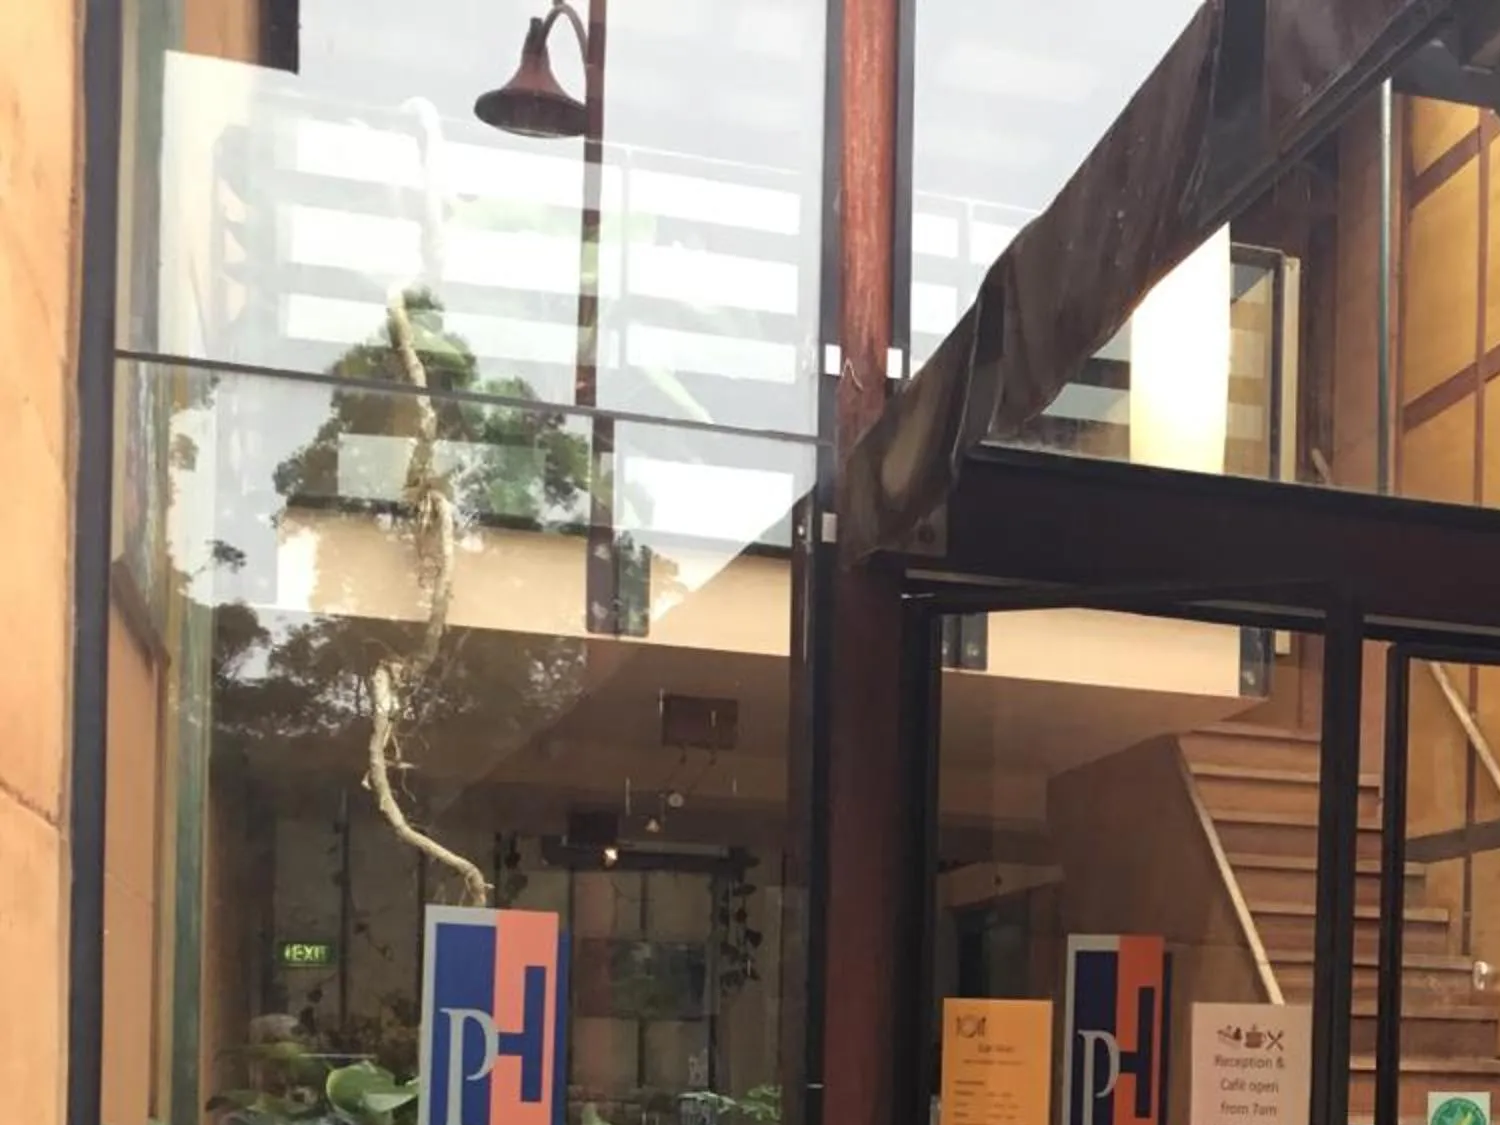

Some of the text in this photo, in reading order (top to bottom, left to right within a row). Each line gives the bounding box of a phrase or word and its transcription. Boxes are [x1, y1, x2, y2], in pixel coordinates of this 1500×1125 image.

[290, 943, 328, 961] EXIT
[1213, 1054, 1285, 1069] Reception &
[1248, 1081, 1279, 1094] open
[1220, 1100, 1278, 1116] from 7am
